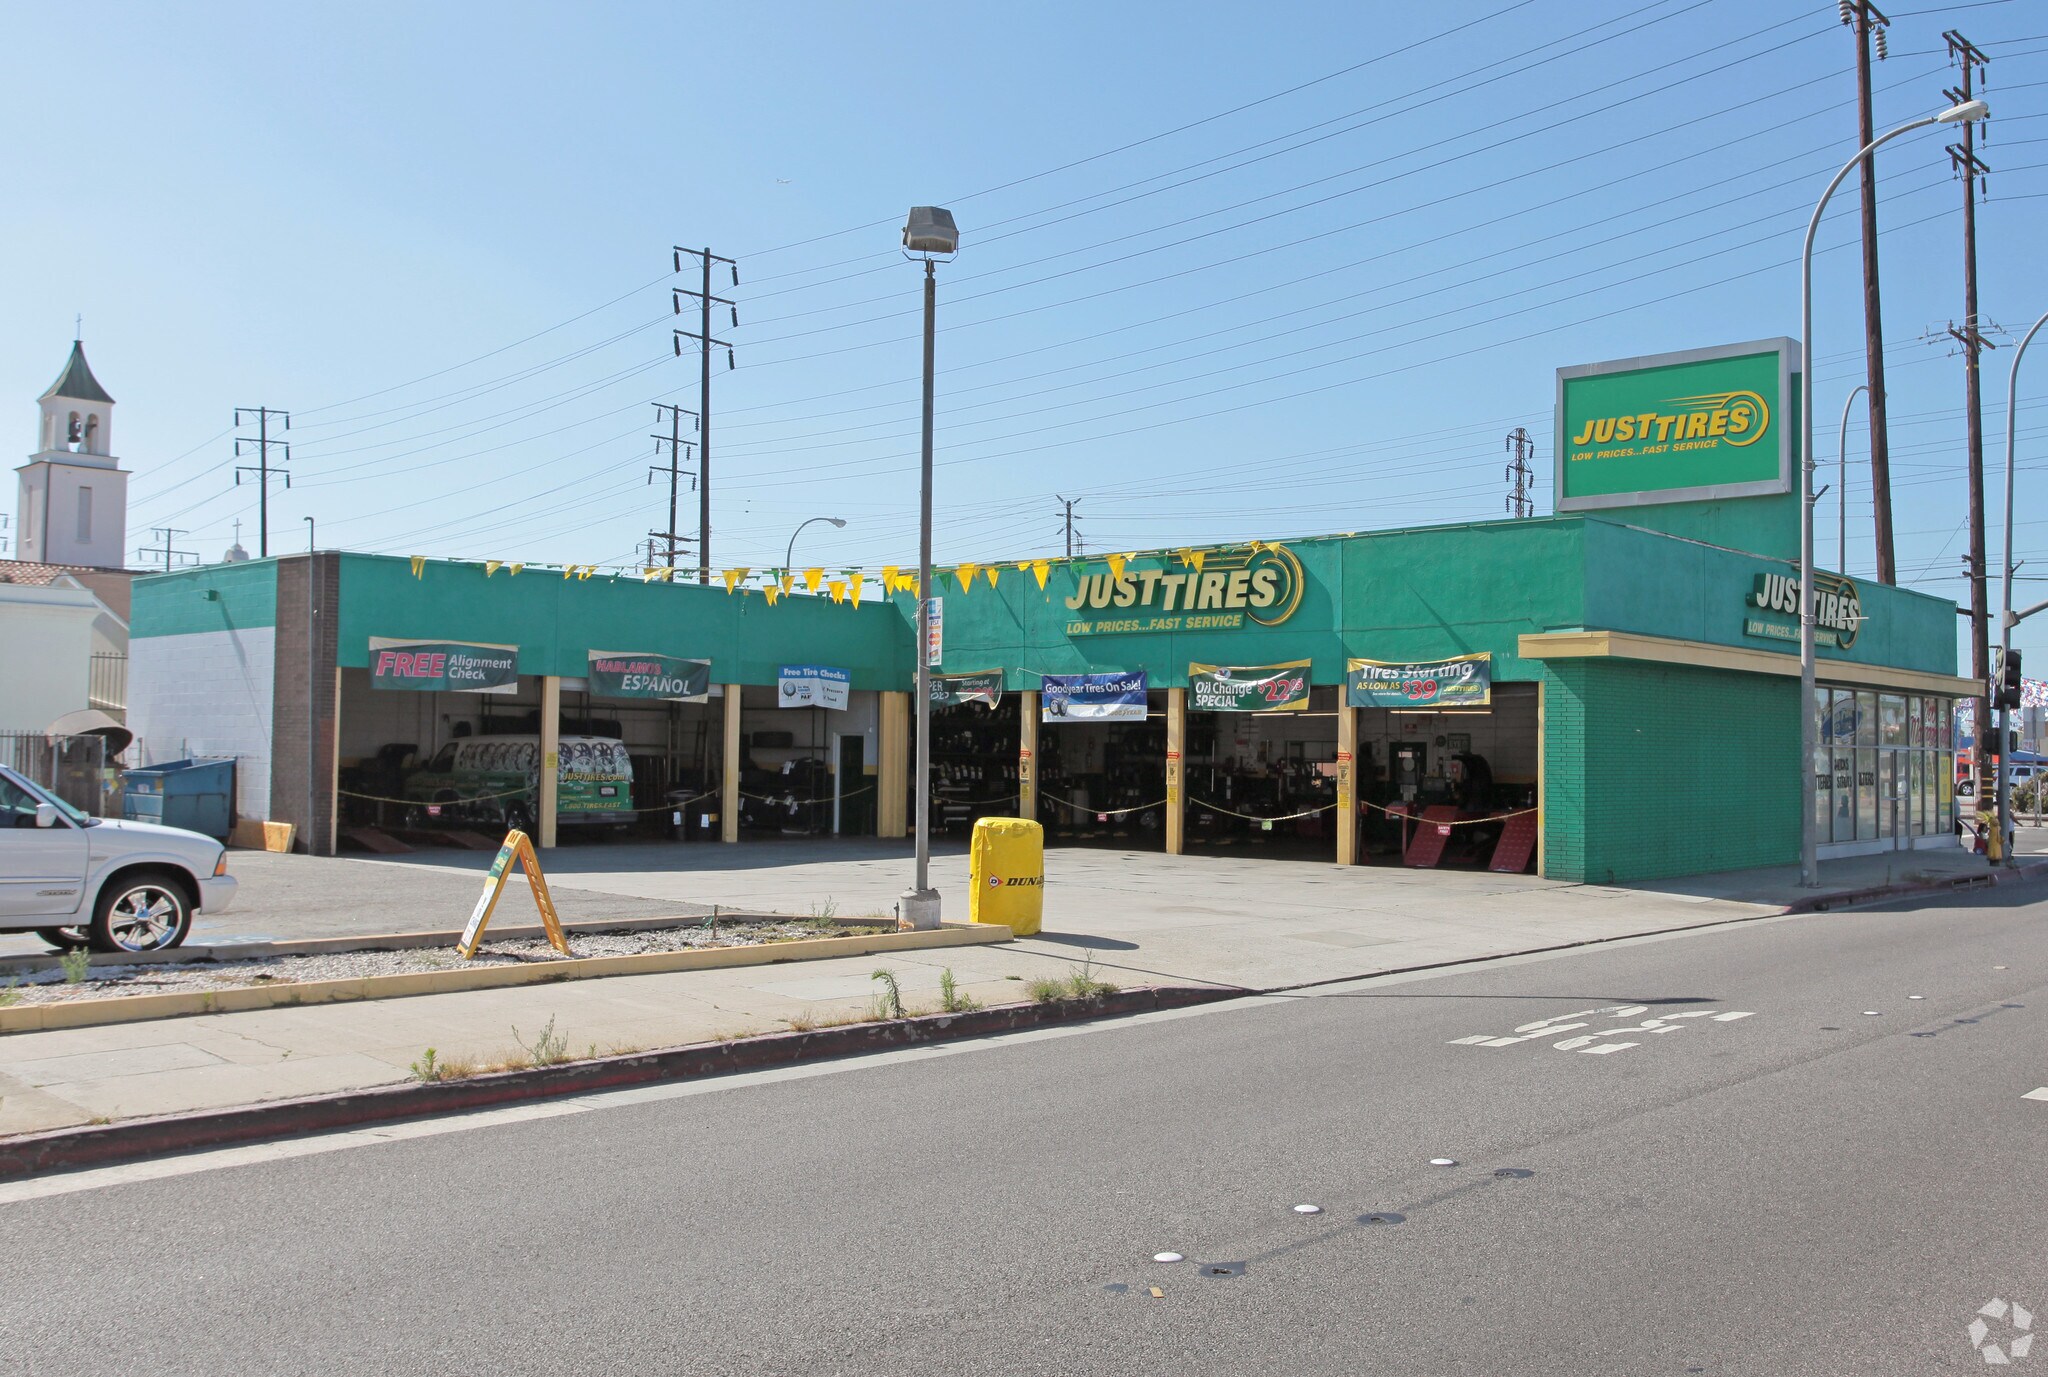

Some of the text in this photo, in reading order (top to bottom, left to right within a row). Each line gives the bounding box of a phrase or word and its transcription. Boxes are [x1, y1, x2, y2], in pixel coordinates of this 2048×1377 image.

[1572, 452, 1593, 461] LOW
[1673, 440, 1718, 452] SERVICE
[1067, 621, 1092, 634] LOW
[1186, 615, 1242, 629] SERVICE
[1748, 621, 1763, 632] LOW
[376, 651, 512, 678] FREE Alignment
[596, 660, 662, 674] HABLAMOS
[1360, 662, 1473, 680] Tires Starting
[448, 667, 486, 680] Check
[784, 668, 846, 679] Free Tire Checks
[621, 673, 691, 695] ESPAÑOL
[929, 681, 943, 691] PER
[961, 679, 984, 687] Starting
[1045, 680, 1141, 695] Goodyear Tires On Sale!
[1195, 681, 1253, 697] Oil Change
[1356, 681, 1400, 690] AS LOW AS
[1402, 680, 1437, 700] $39
[1195, 694, 1239, 707] SPECIAL
